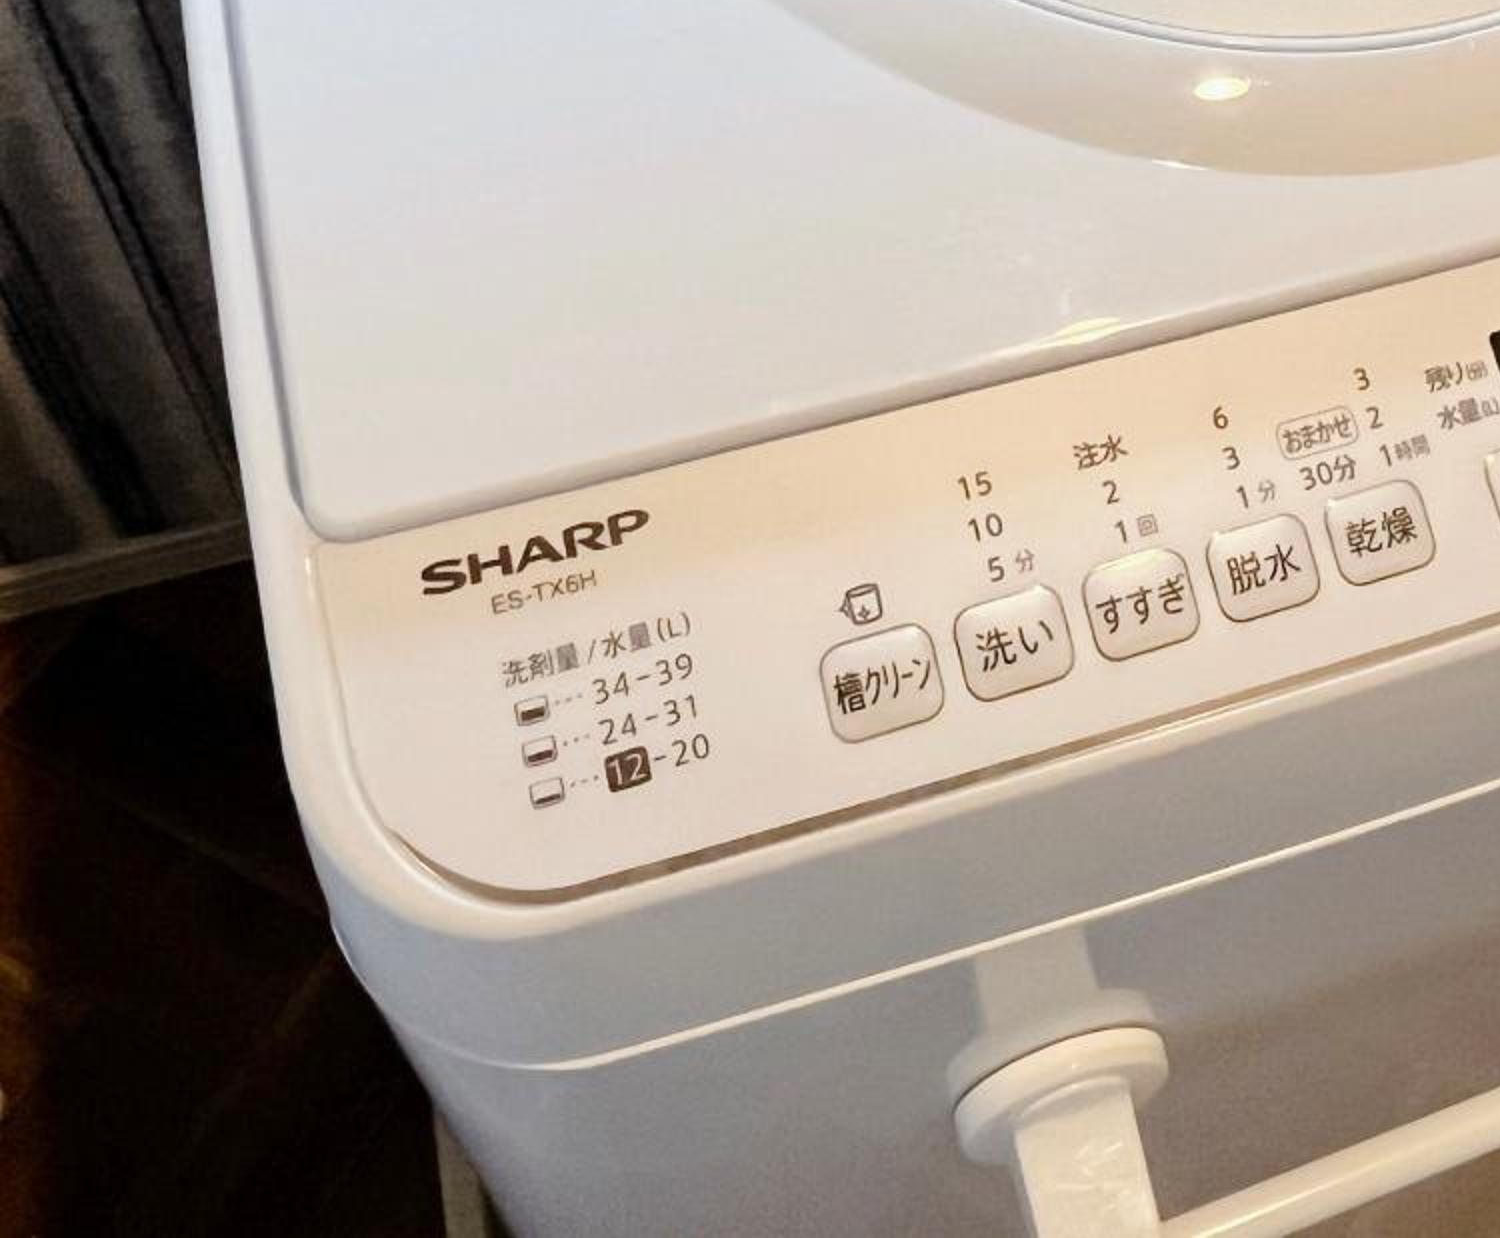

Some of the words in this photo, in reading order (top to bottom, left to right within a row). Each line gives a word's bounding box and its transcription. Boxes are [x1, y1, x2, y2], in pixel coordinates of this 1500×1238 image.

[1354, 368, 1369, 391] 3
[1213, 407, 1228, 429] 6
[1283, 414, 1352, 453] おまかせ
[1367, 408, 1382, 429] 2
[1073, 435, 1128, 470] 注水
[1223, 447, 1239, 469] 3
[958, 471, 992, 500] 15
[1300, 455, 1356, 490] 30分
[1103, 480, 1119, 504] 2
[968, 514, 1003, 541] 10
[1346, 505, 1418, 557] 乾燥
[421, 509, 650, 595] SHARP
[1227, 545, 1300, 595] 脱水
[492, 570, 597, 615] ES-TX6H
[1096, 574, 1185, 634] すすぎ
[976, 621, 1053, 672] 洗い
